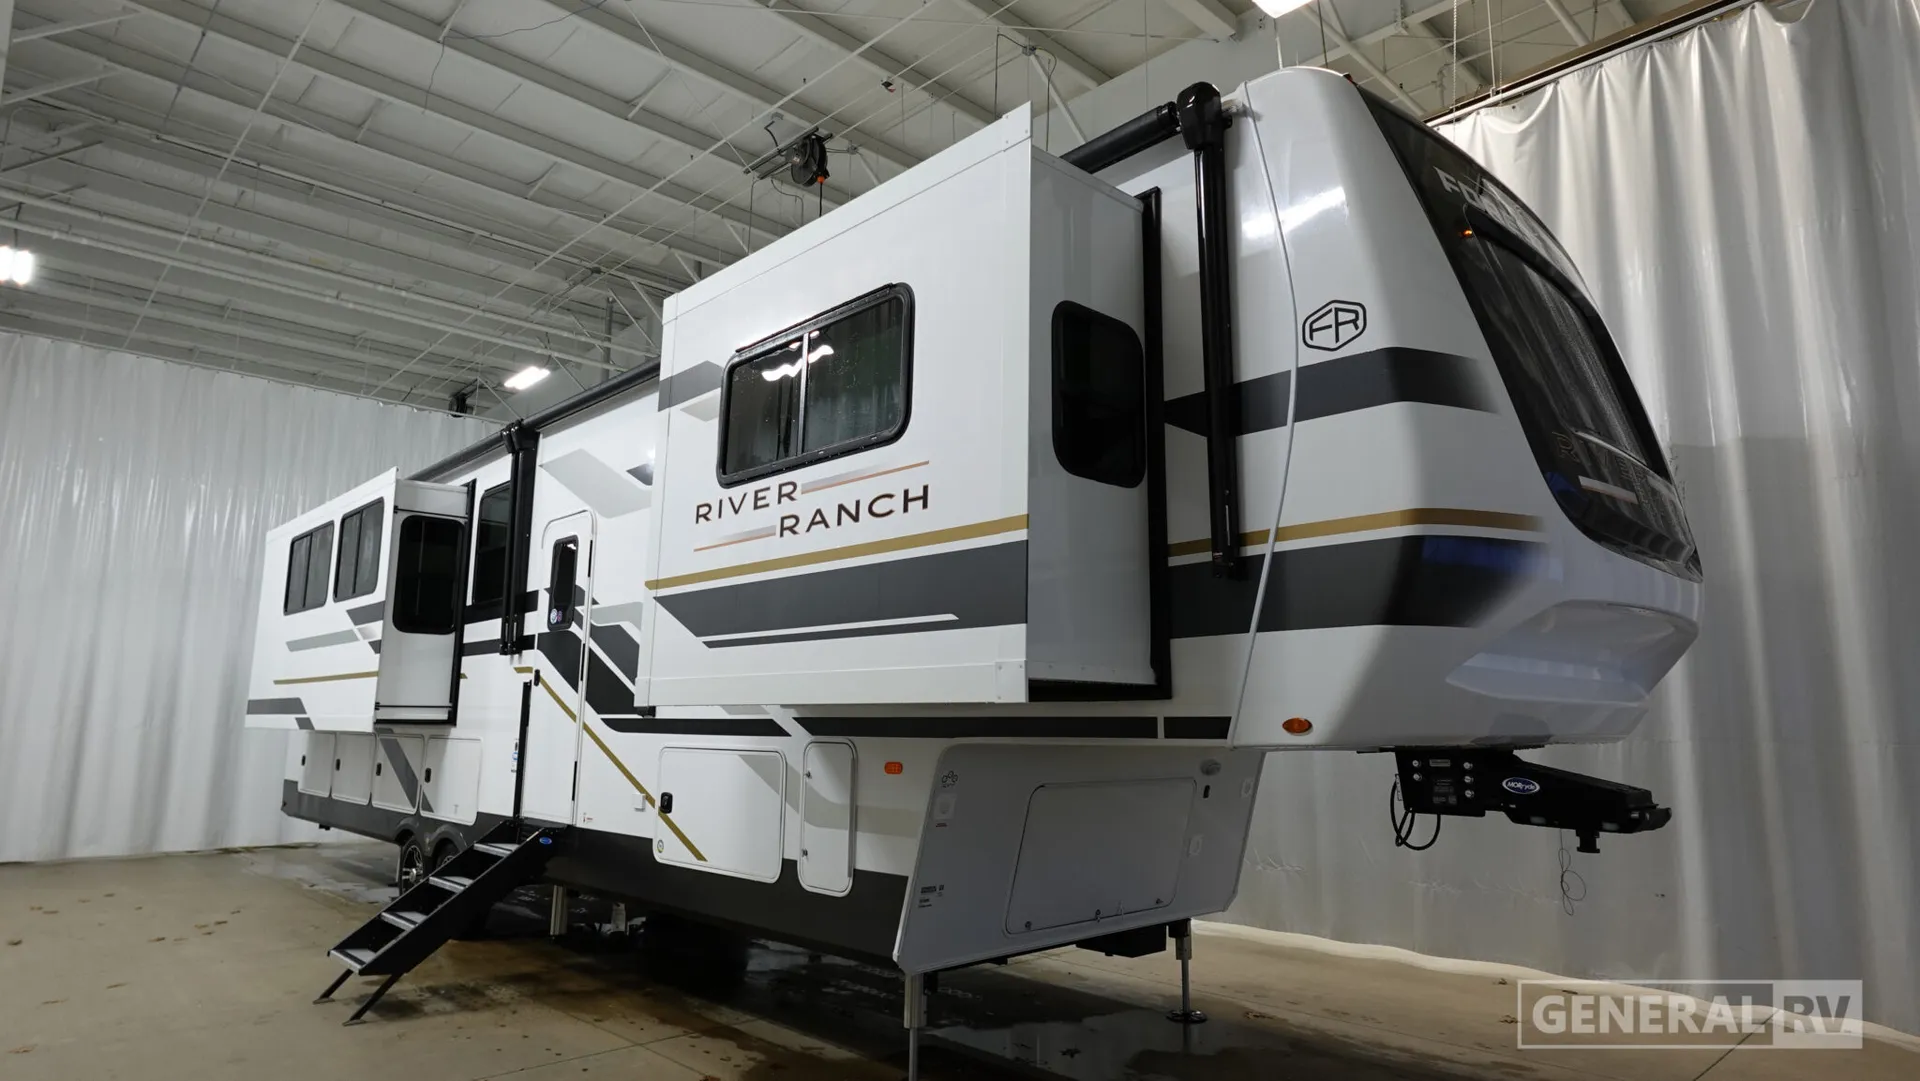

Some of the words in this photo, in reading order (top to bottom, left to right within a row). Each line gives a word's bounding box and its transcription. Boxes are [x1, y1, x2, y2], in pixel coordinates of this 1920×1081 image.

[1309, 308, 1360, 343] FR
[695, 481, 799, 524] RIVER
[779, 484, 930, 538] RANCH
